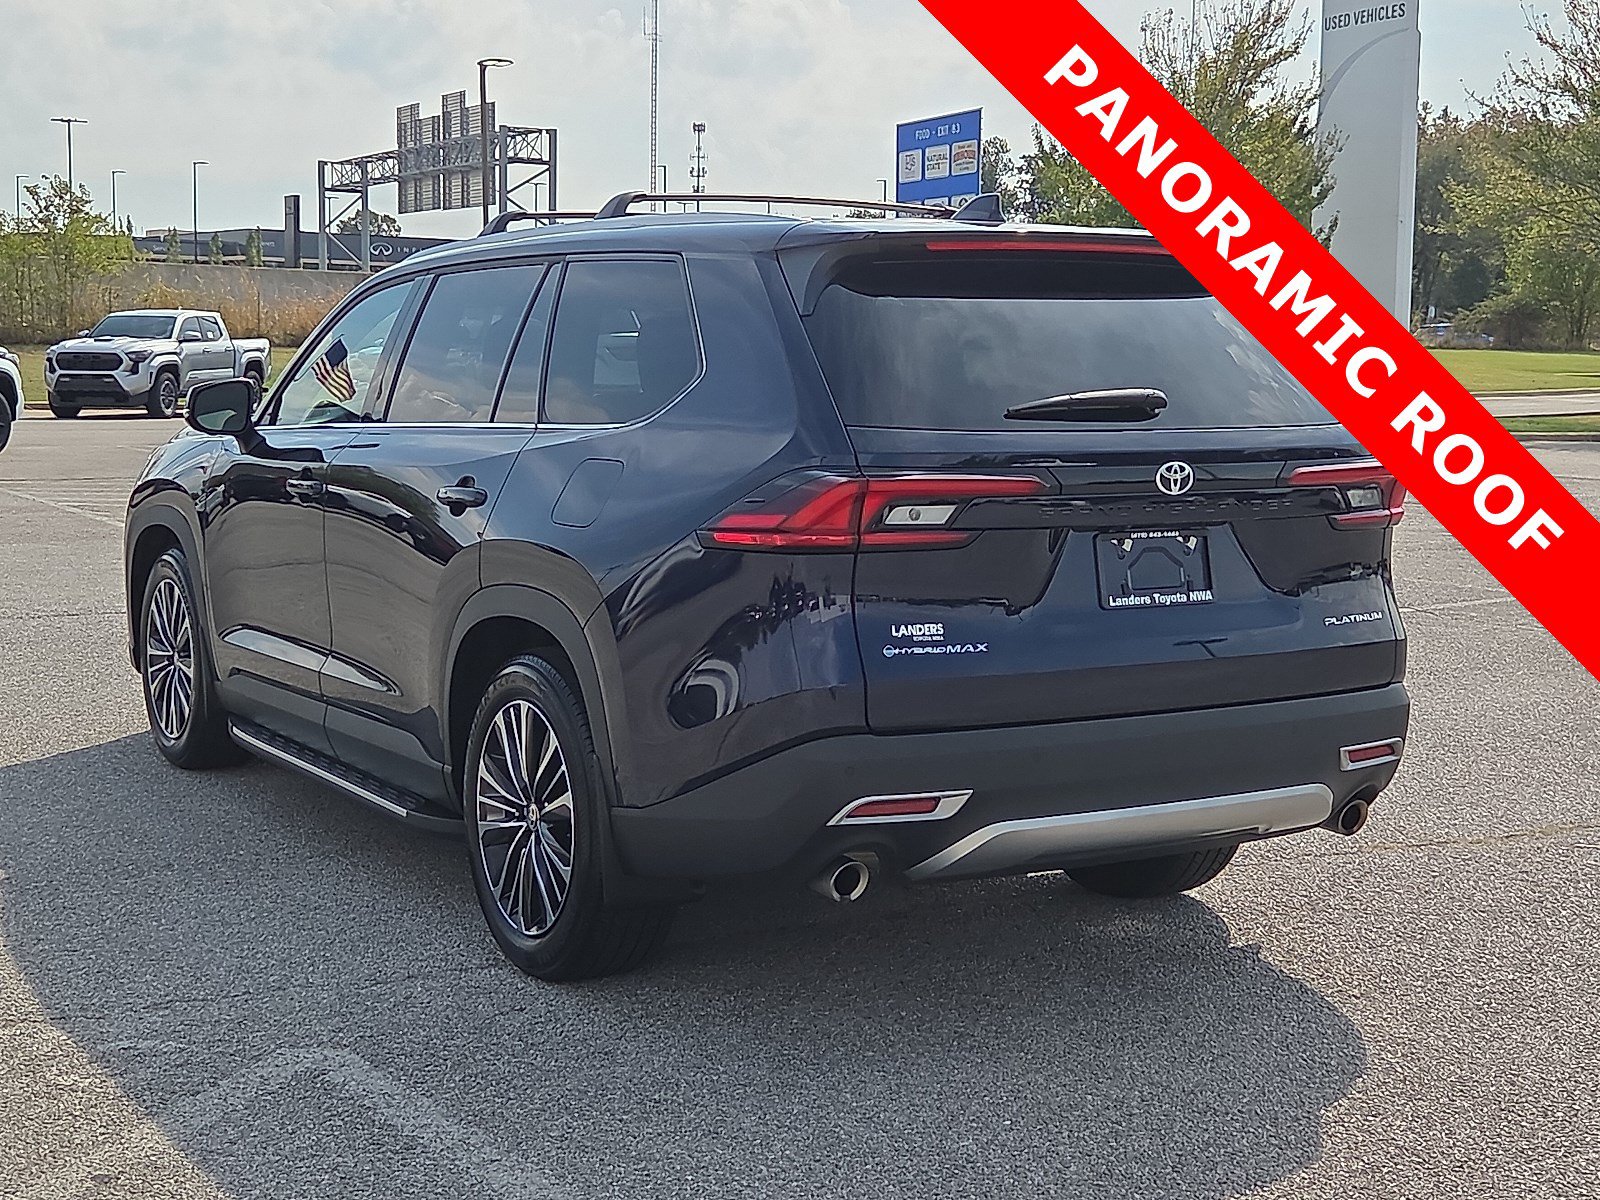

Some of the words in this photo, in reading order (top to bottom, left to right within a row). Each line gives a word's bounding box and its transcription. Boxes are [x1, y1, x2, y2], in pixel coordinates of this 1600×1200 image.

[1324, 13, 1351, 31] USED
[1353, 3, 1406, 26] VEHICLES
[915, 128, 930, 140] FOOD
[937, 125, 948, 137] EXIT
[1109, 593, 1151, 606] Landers
[1153, 592, 1187, 606] Toyota
[1189, 590, 1213, 602] NWA
[1324, 611, 1383, 626] PLATINUM
[891, 622, 944, 637] LANDERS
